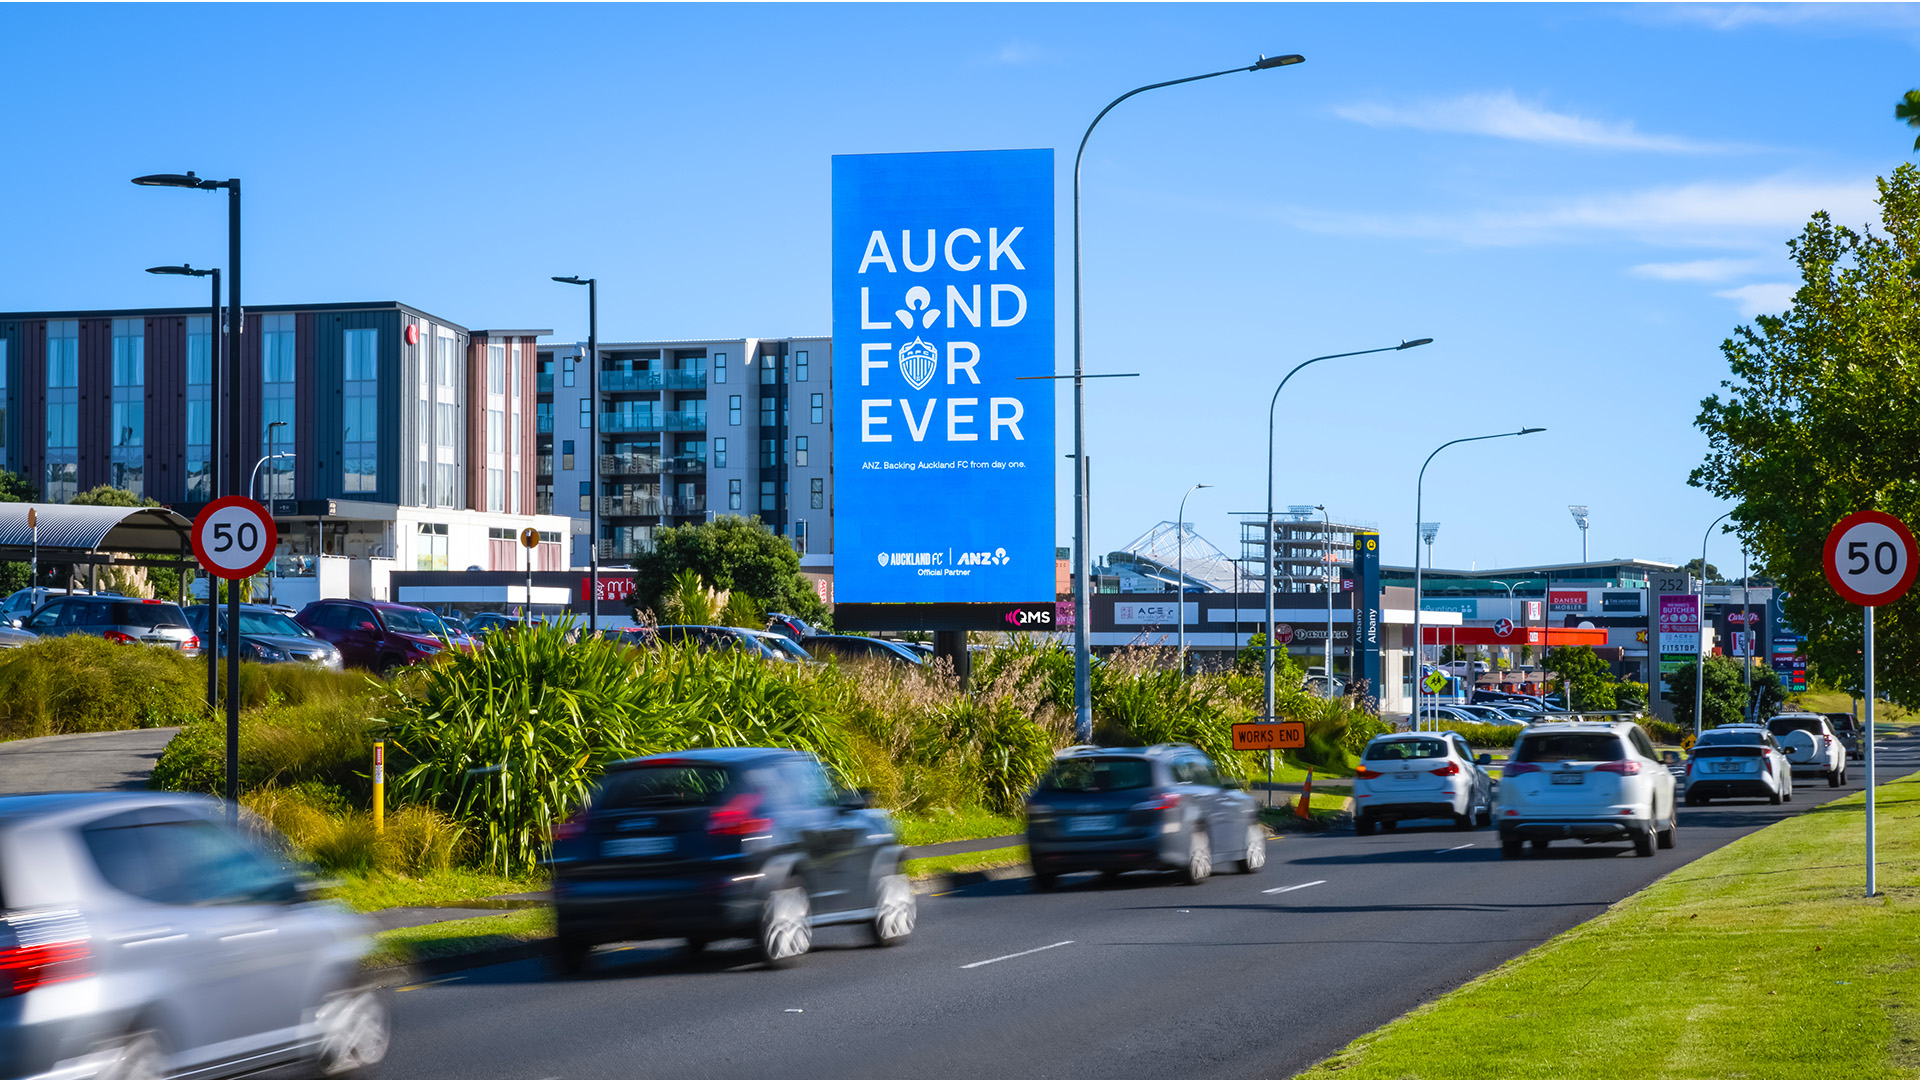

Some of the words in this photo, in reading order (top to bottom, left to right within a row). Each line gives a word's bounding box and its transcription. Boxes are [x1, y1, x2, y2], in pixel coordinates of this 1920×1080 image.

[858, 226, 1026, 274] AUCK
[861, 397, 1025, 442] EVER
[862, 461, 882, 470] ANZ.
[883, 461, 916, 471] Backing
[917, 461, 956, 469] Auckland
[957, 461, 969, 469] FC
[970, 461, 990, 469] from
[991, 460, 1007, 470] day
[1008, 461, 1027, 469] one.
[213, 522, 258, 552] 50
[890, 552, 931, 566] AUCKLAND
[932, 552, 944, 566] FC
[957, 552, 992, 566] ANZ
[1848, 541, 1898, 575] 50
[917, 568, 943, 576] Official
[944, 568, 971, 576] Partner
[1658, 578, 1684, 591] 252
[1011, 608, 1051, 626] QMS
[1662, 606, 1696, 614] BUTCHER
[1355, 608, 1363, 644] Albany
[1367, 608, 1378, 644] Albany
[1238, 729, 1274, 744] WORKS
[1279, 728, 1300, 742] END
